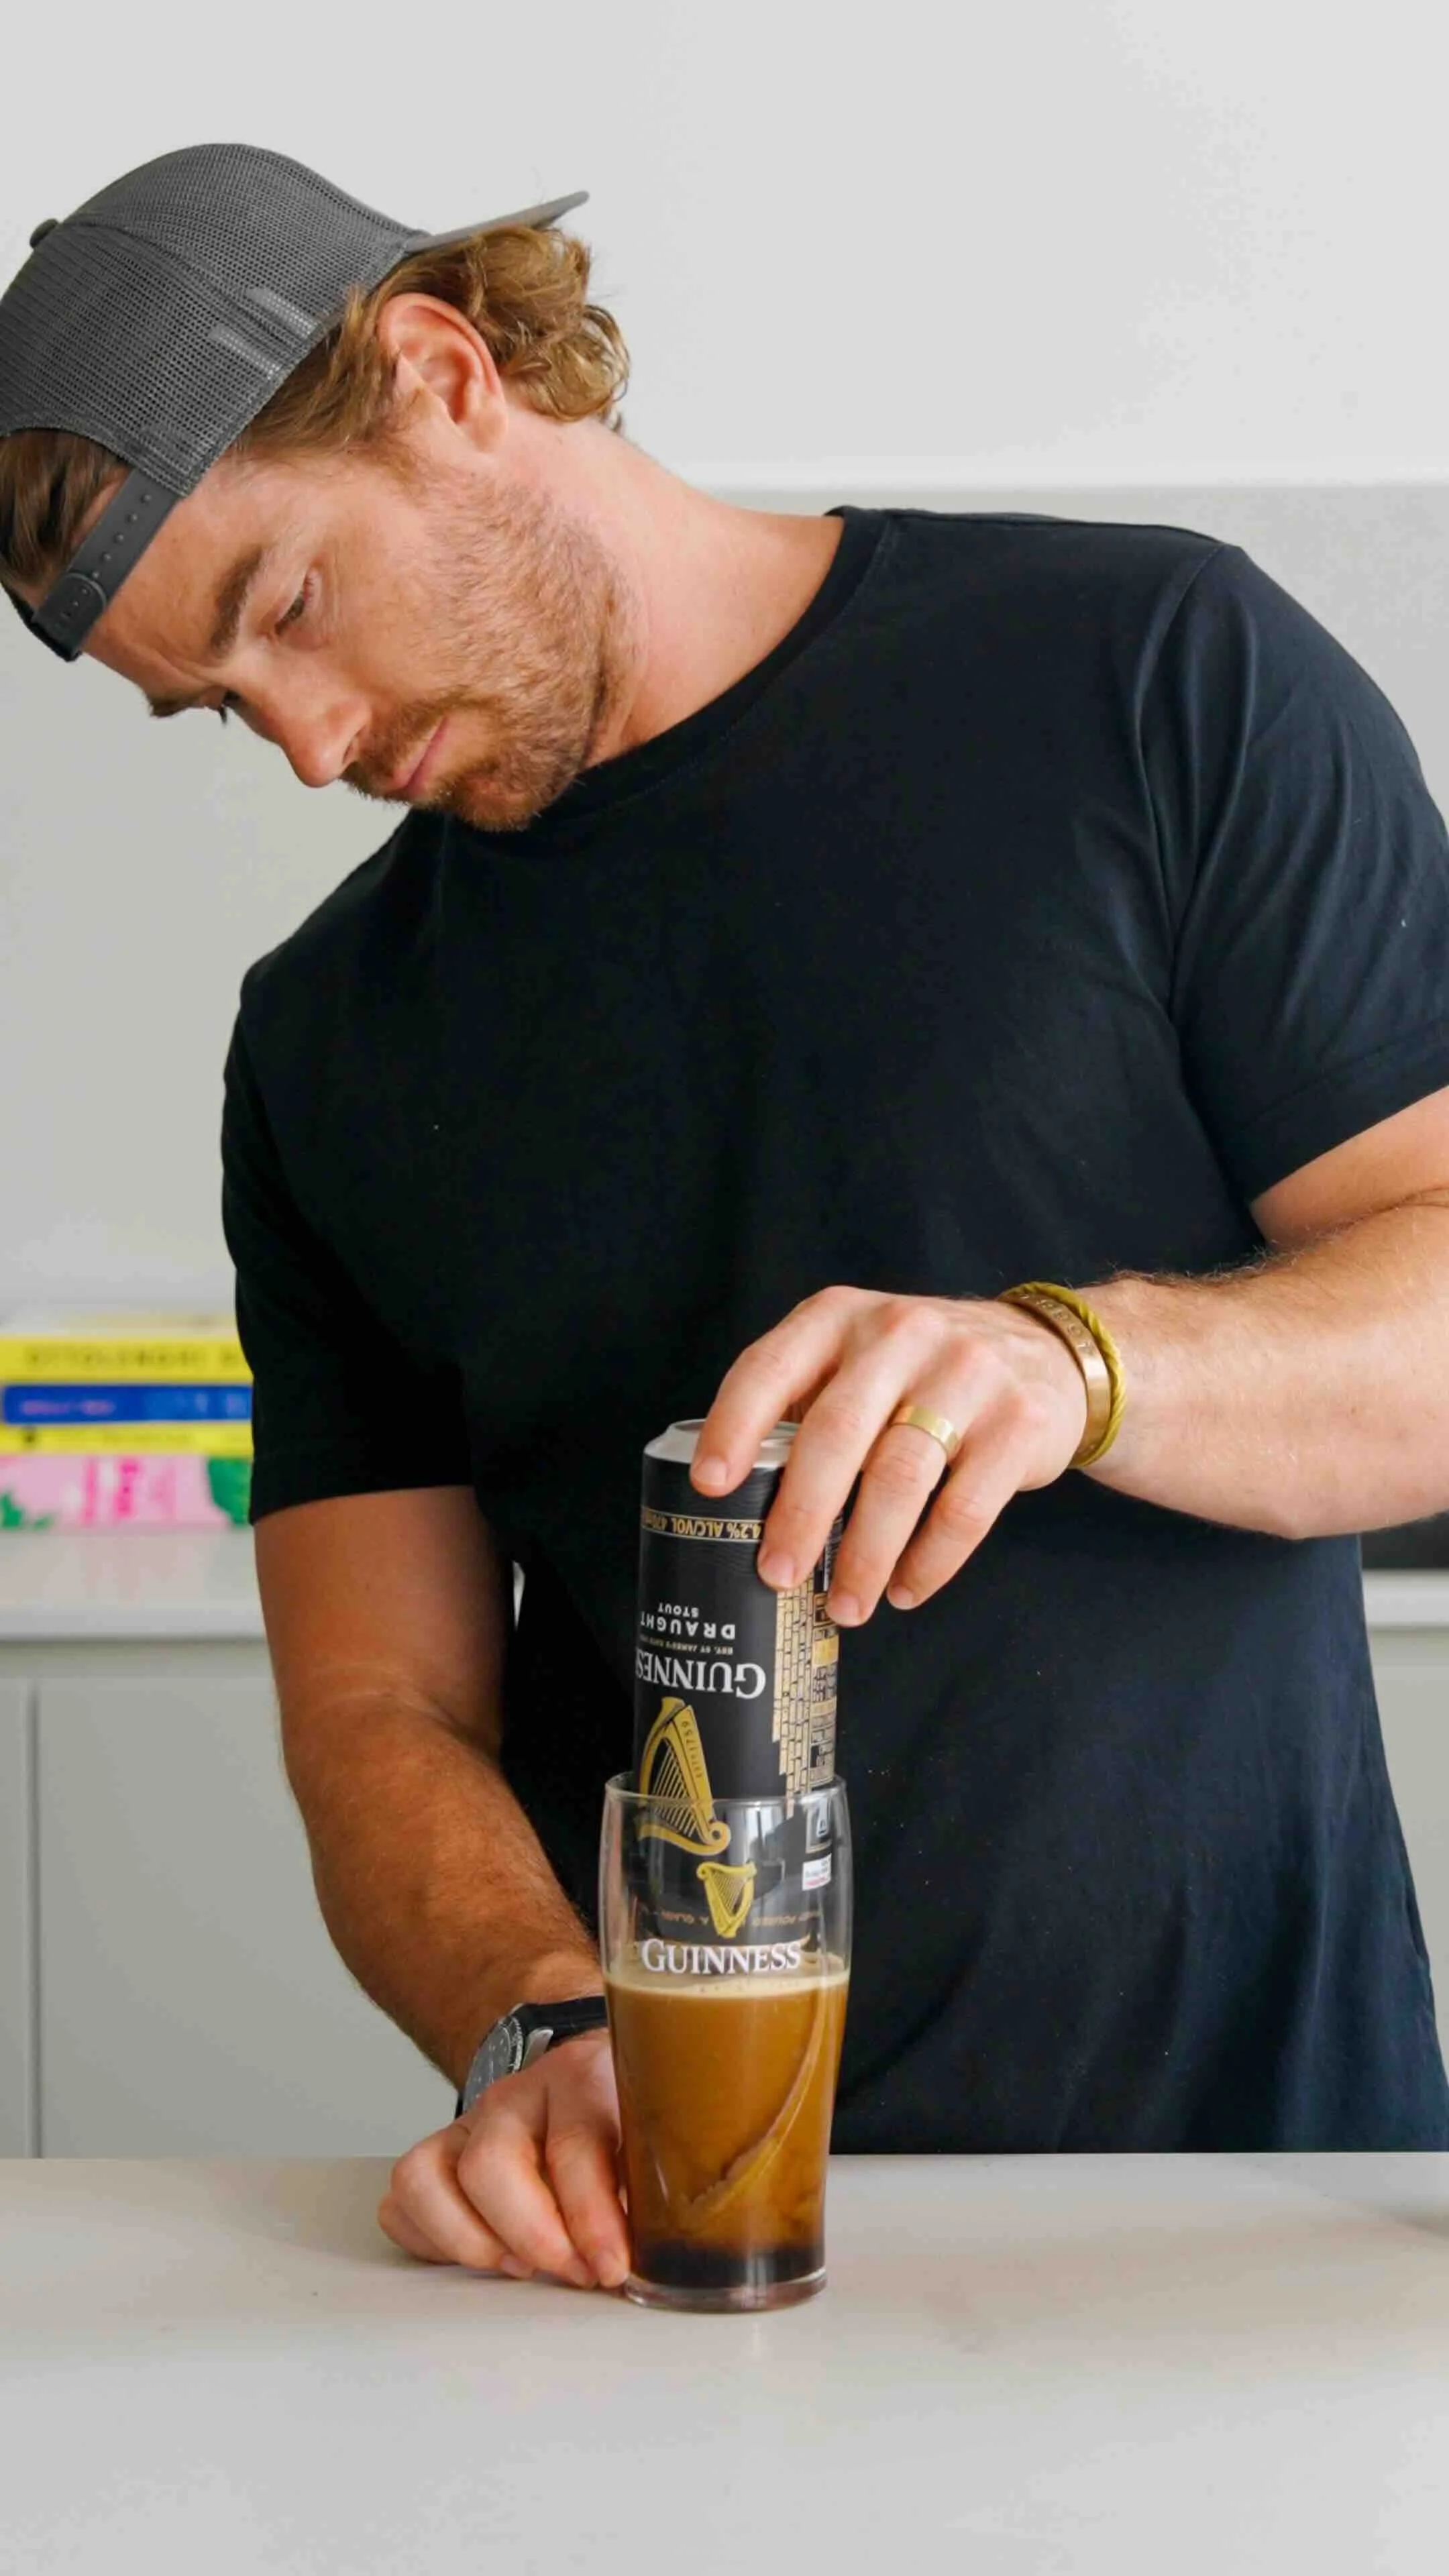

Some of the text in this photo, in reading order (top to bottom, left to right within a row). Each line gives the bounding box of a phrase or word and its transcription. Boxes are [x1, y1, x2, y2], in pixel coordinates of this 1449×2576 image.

[672, 1517, 724, 1537] ALC/VOL
[727, 1521, 761, 1539] 4.2%
[658, 1603, 699, 1618] STOUT
[640, 1611, 736, 1640] DRAUGHT
[641, 1938, 802, 1974] GUINNESS
